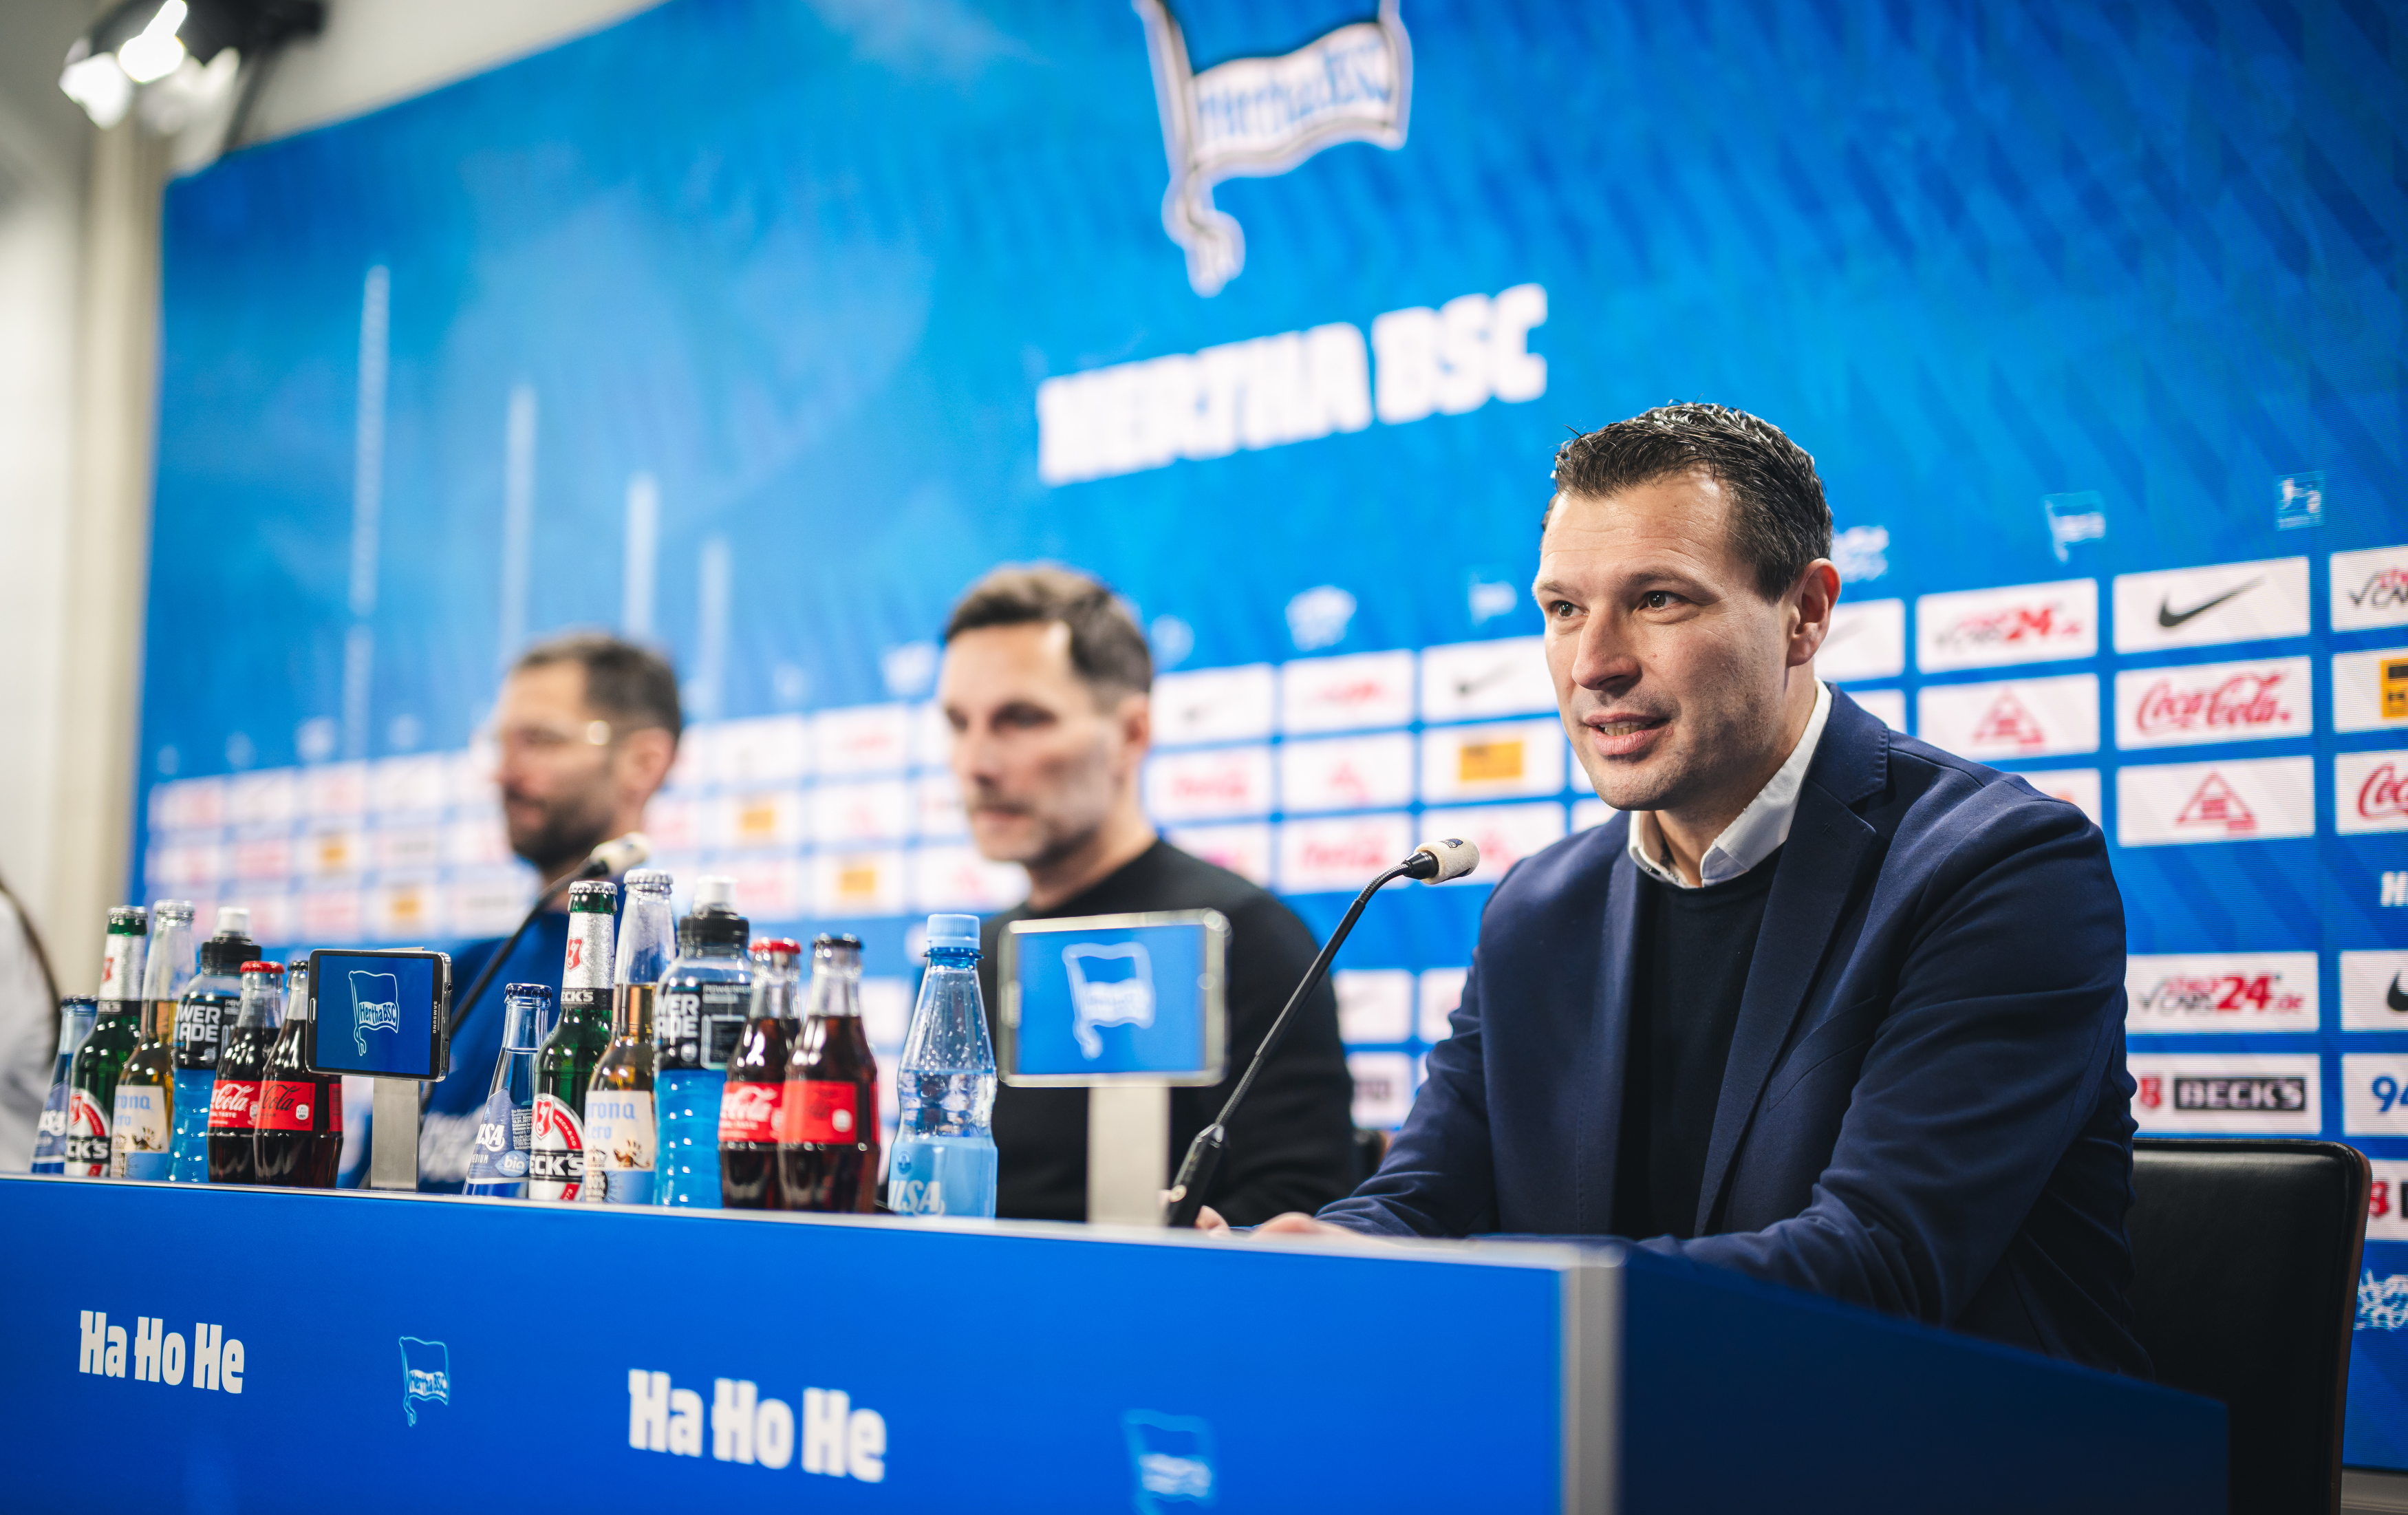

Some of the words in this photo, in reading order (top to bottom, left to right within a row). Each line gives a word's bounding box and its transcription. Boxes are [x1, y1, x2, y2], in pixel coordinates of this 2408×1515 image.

[1038, 322, 1373, 486] HERTHA
[1373, 283, 1547, 425] BSC
[561, 989, 594, 1002] ECK'S
[175, 1004, 220, 1024] WER
[2180, 1082, 2303, 1109] BECK'S
[504, 1154, 525, 1170] bio
[529, 1152, 584, 1177] ECK'S
[888, 1179, 946, 1217] ILSA
[79, 1310, 127, 1379] Ha
[134, 1316, 186, 1387] Ho
[193, 1322, 245, 1395] He
[628, 1368, 703, 1458] Ha
[711, 1377, 794, 1470] Ho
[801, 1386, 888, 1483] He
